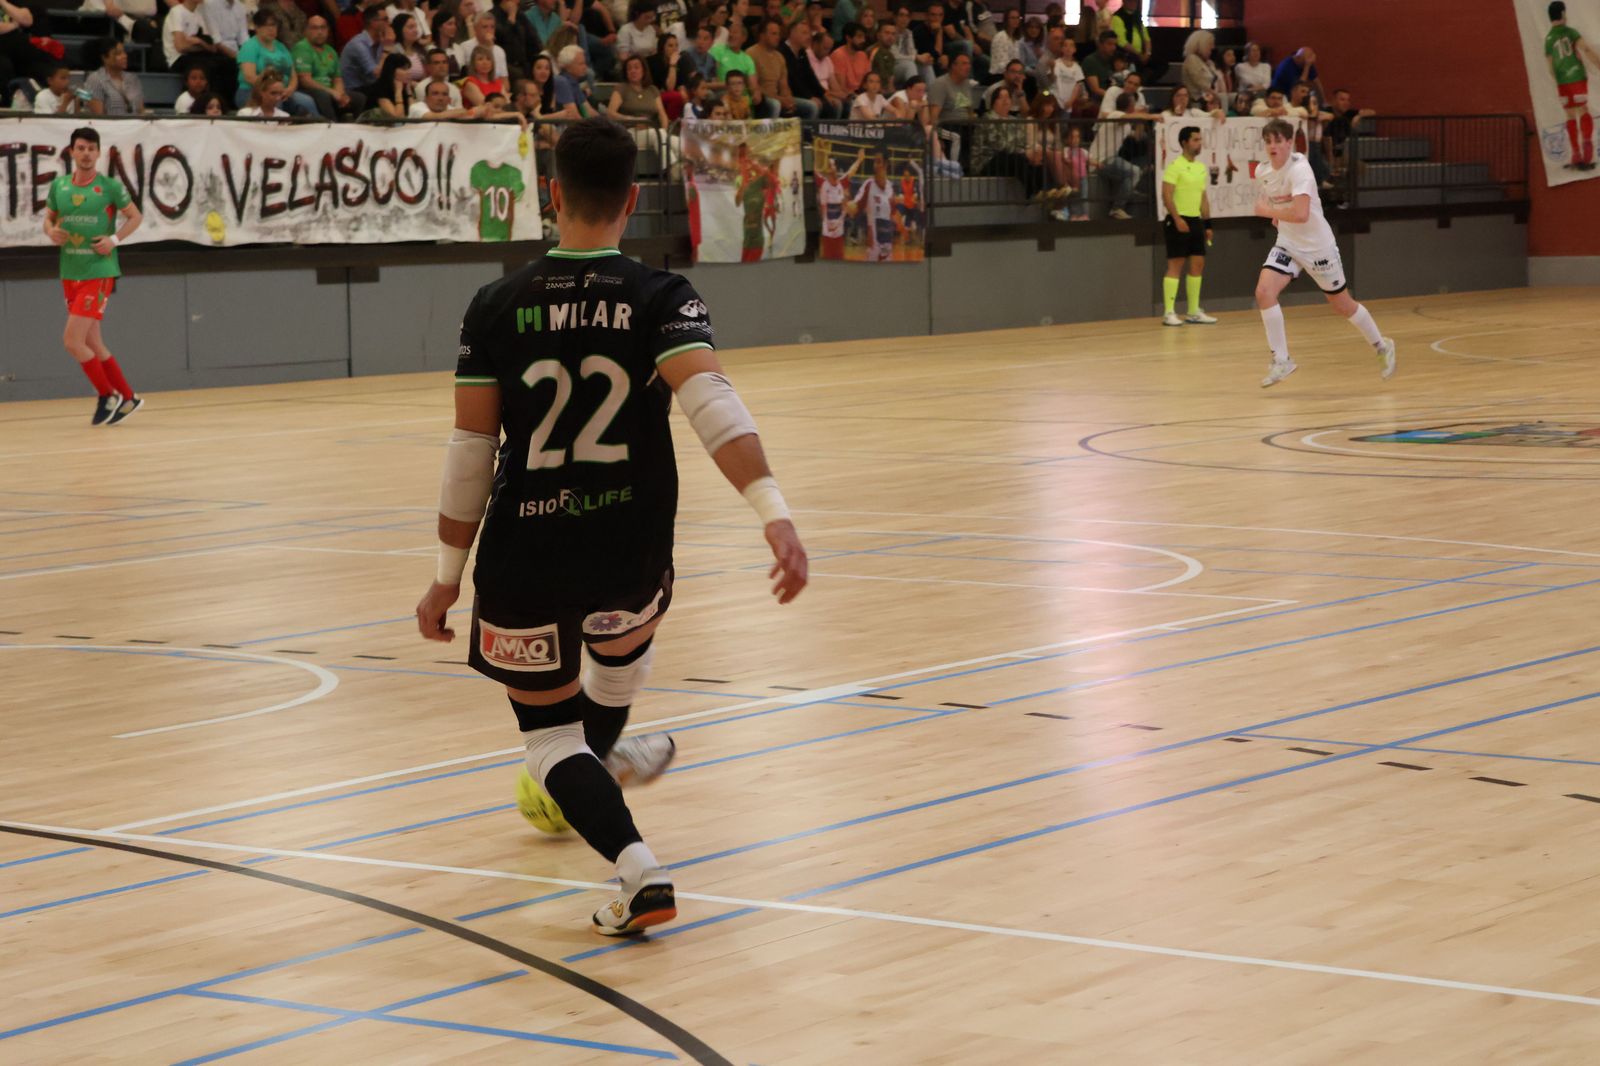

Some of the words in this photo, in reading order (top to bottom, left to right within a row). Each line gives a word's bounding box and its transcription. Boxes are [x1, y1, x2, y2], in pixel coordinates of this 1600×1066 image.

[1553, 36, 1573, 59] 10
[484, 186, 509, 221] 10
[545, 281, 576, 290] ZAMORA
[549, 300, 633, 331] MILAR
[521, 354, 630, 470] 22
